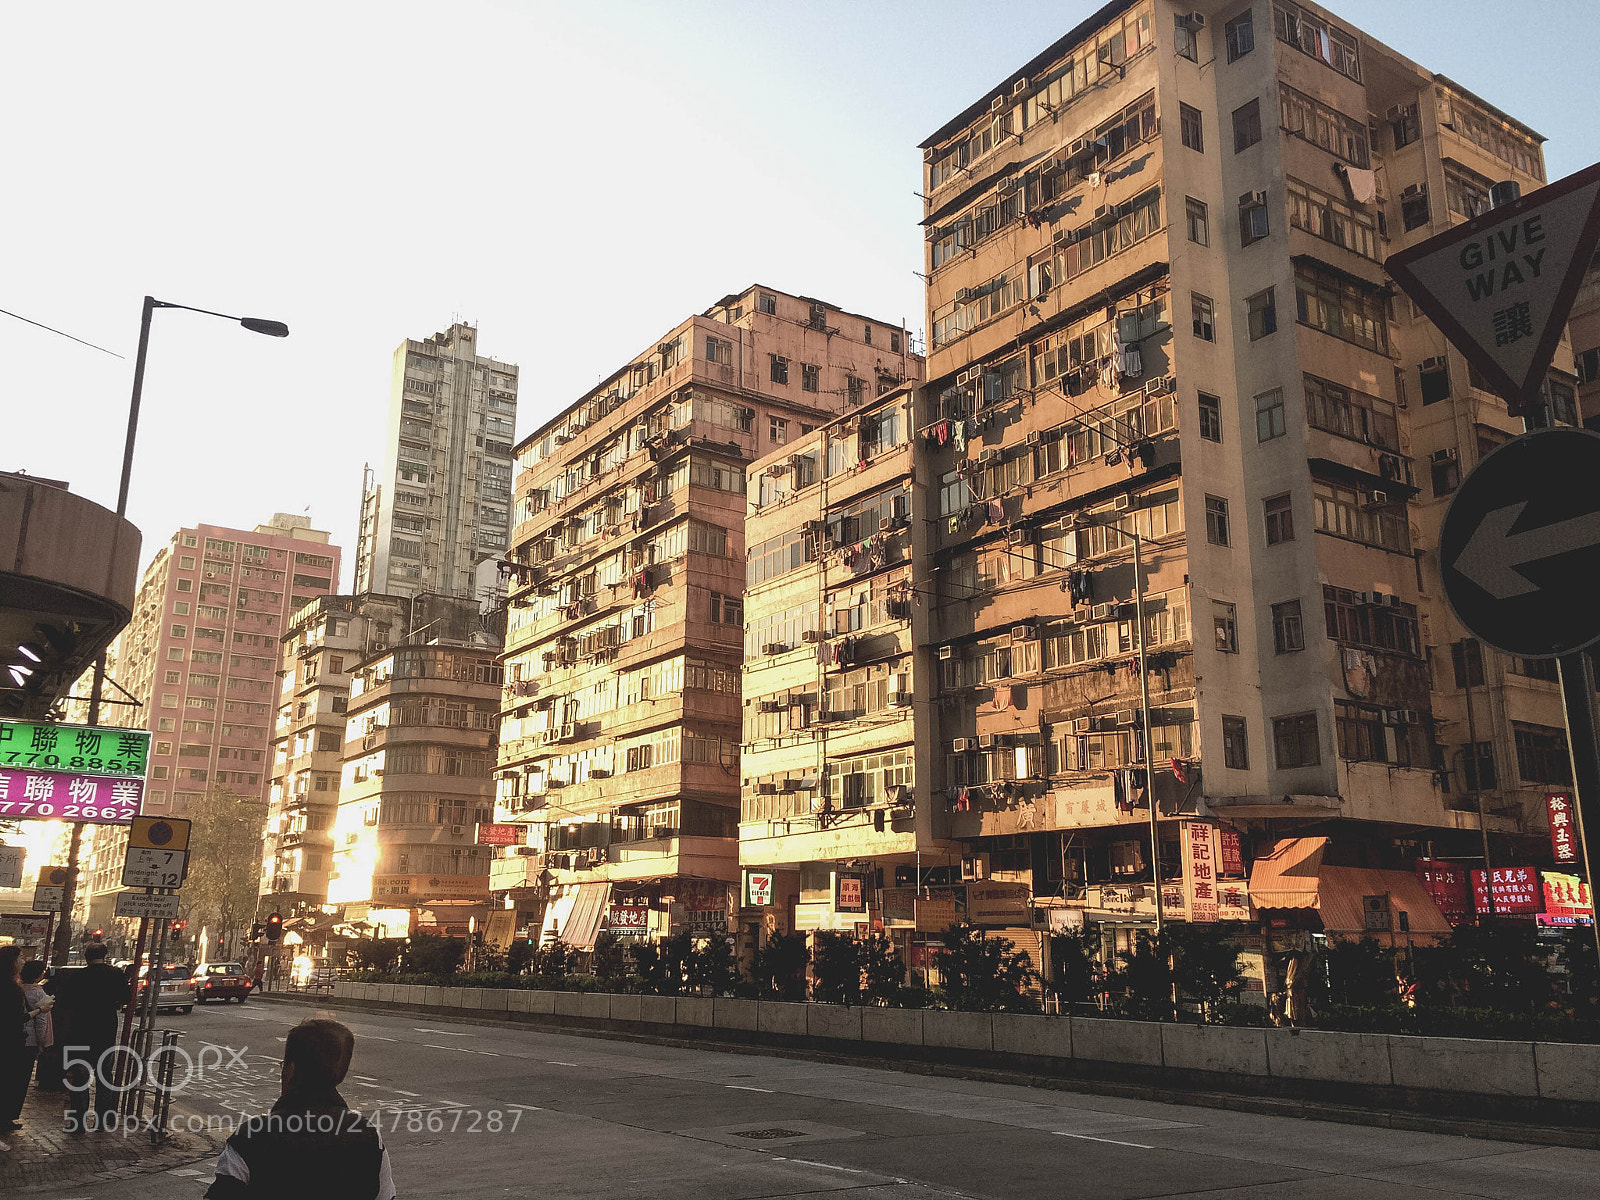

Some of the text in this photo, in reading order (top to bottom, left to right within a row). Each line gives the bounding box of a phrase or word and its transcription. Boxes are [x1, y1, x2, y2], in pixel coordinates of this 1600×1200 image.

[1460, 214, 1546, 271] GIVE
[1465, 248, 1546, 302] WAY
[1492, 302, 1534, 347] 讓
[69, 756, 142, 772] 8855
[0, 802, 136, 820] 770 2662
[164, 852, 174, 865] 7
[1191, 824, 1213, 899] 祥記地產
[161, 873, 178, 886] 12
